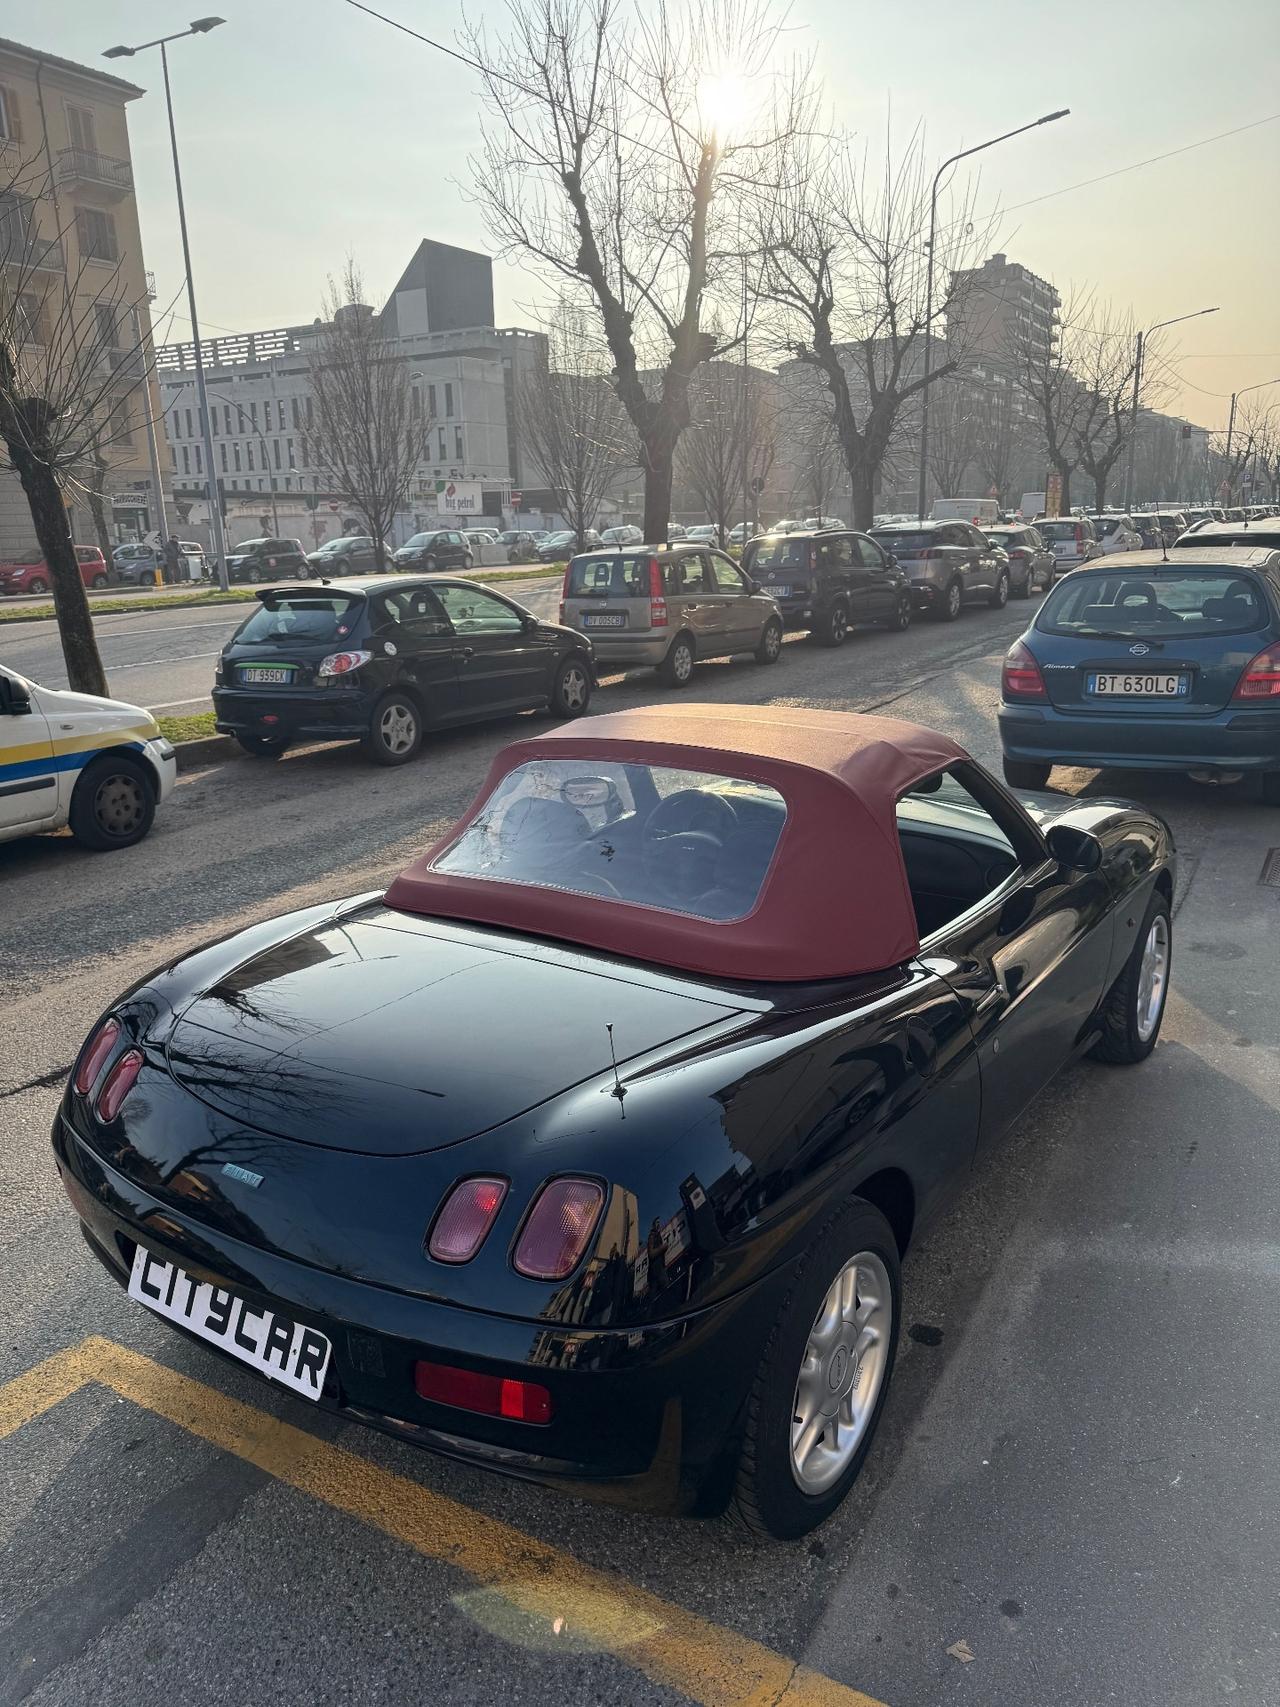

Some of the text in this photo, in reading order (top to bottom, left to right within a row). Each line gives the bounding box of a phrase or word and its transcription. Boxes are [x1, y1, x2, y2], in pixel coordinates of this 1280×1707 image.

[247, 669, 256, 681] DT
[1097, 676, 1118, 692] BT
[1123, 676, 1176, 694] 630LG
